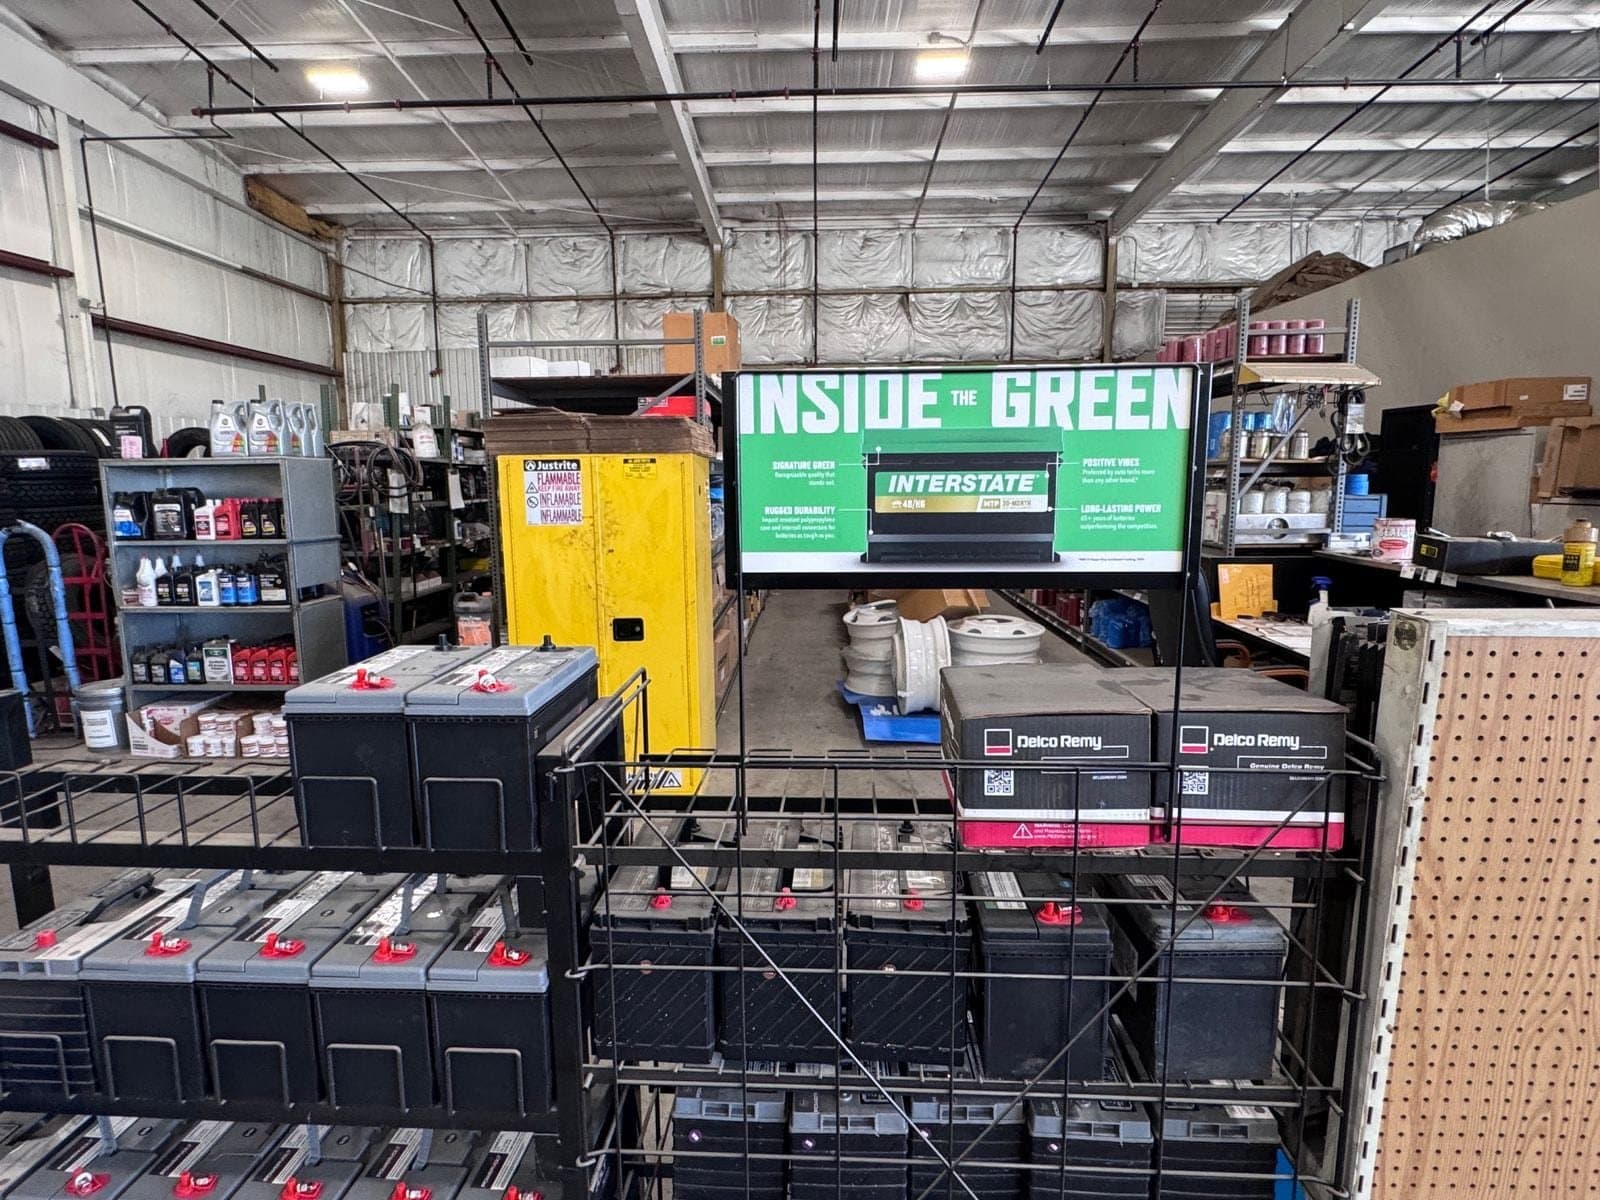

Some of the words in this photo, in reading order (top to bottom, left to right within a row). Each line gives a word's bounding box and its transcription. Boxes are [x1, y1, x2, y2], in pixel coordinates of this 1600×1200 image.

[740, 373, 942, 434] INSIDE
[951, 390, 977, 406] THE
[992, 369, 1190, 430] GREEN
[537, 460, 578, 471] Justrite
[772, 461, 811, 470] SIGNATURE
[812, 461, 836, 470] GREEN
[1083, 458, 1117, 467] POSITIVE
[1118, 458, 1140, 467] VIBES
[537, 472, 581, 485] FLAMMABLE
[888, 473, 1035, 493] INTERSTATE
[540, 493, 581, 506] INFLAMABLE
[764, 506, 793, 515] RUGGED
[794, 506, 836, 515] DURABILITY
[1080, 504, 1134, 513] LONG-LASTING
[1135, 504, 1162, 513] POWER
[541, 509, 582, 522] INFLAMMABLE
[1016, 735, 1058, 748] Delco
[1060, 735, 1102, 751] Remy
[1213, 733, 1255, 746] Delco
[1257, 733, 1300, 750] Remy
